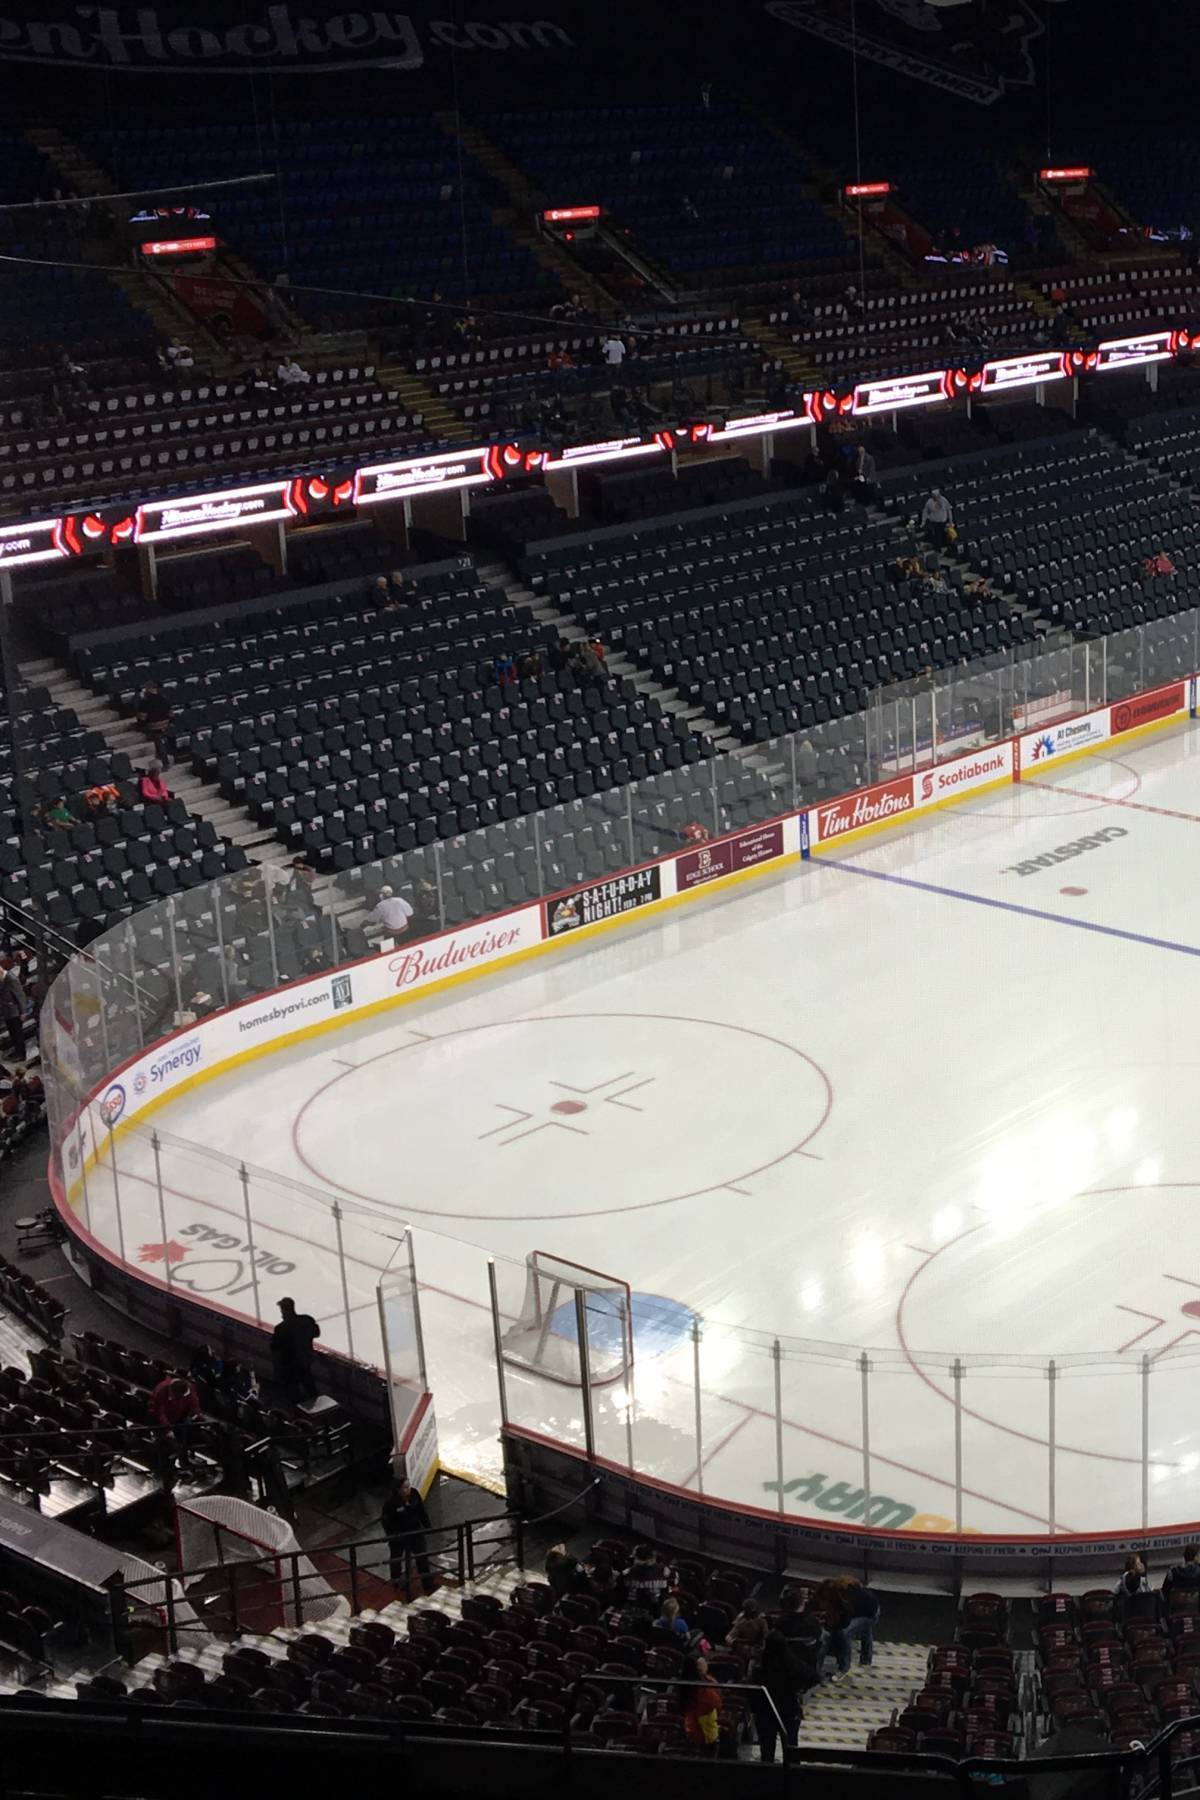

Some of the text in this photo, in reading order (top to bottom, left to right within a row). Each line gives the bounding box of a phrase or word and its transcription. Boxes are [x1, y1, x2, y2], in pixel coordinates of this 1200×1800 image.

[937, 754, 1004, 789] Scotiabank
[820, 804, 850, 837] Tim
[851, 791, 911, 827] Hortons
[702, 862, 725, 876] SCHOOL
[583, 899, 623, 924] NIGHT!
[388, 927, 521, 988] Budweiser
[238, 992, 331, 1033] homesbyavi.com
[149, 1043, 202, 1083] Synergy
[178, 1223, 242, 1250] GAS
[253, 1250, 297, 1275] OIL
